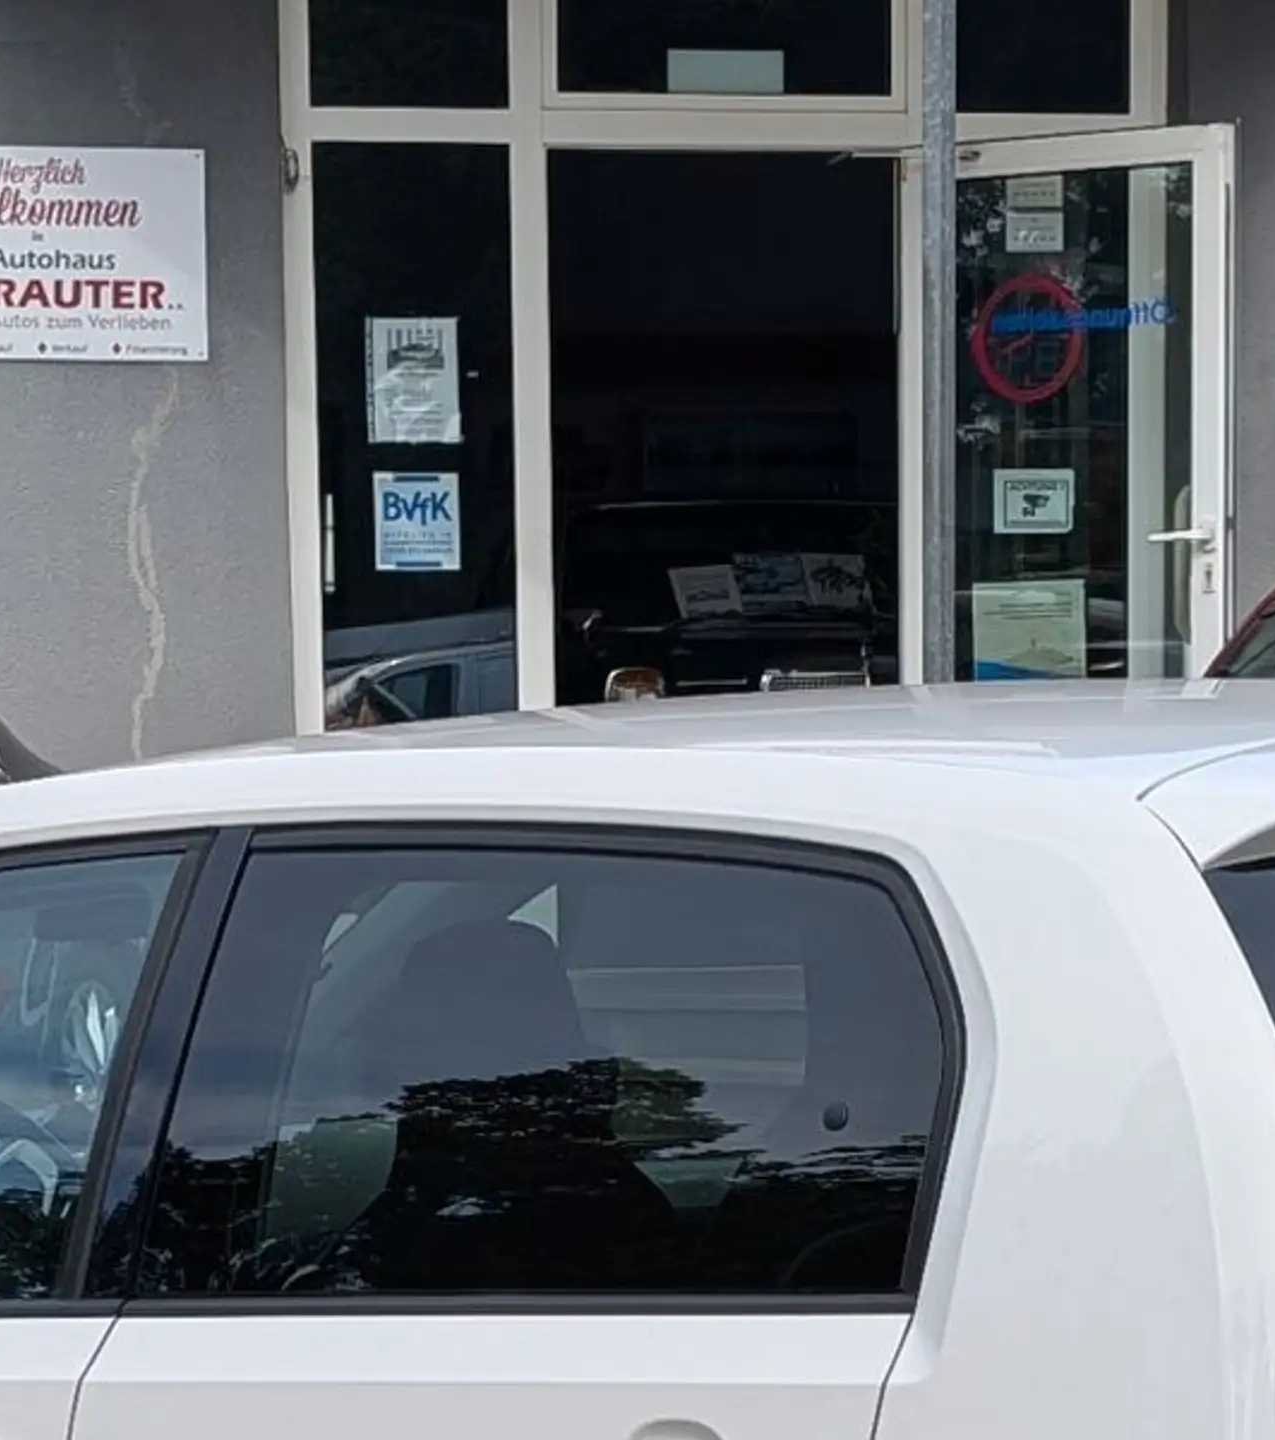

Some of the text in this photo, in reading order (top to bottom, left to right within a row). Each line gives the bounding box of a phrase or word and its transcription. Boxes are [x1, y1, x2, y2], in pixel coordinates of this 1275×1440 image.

[47, 318, 82, 330] zum
[89, 314, 172, 331] Verlieben
[382, 491, 452, 527] BVfK
